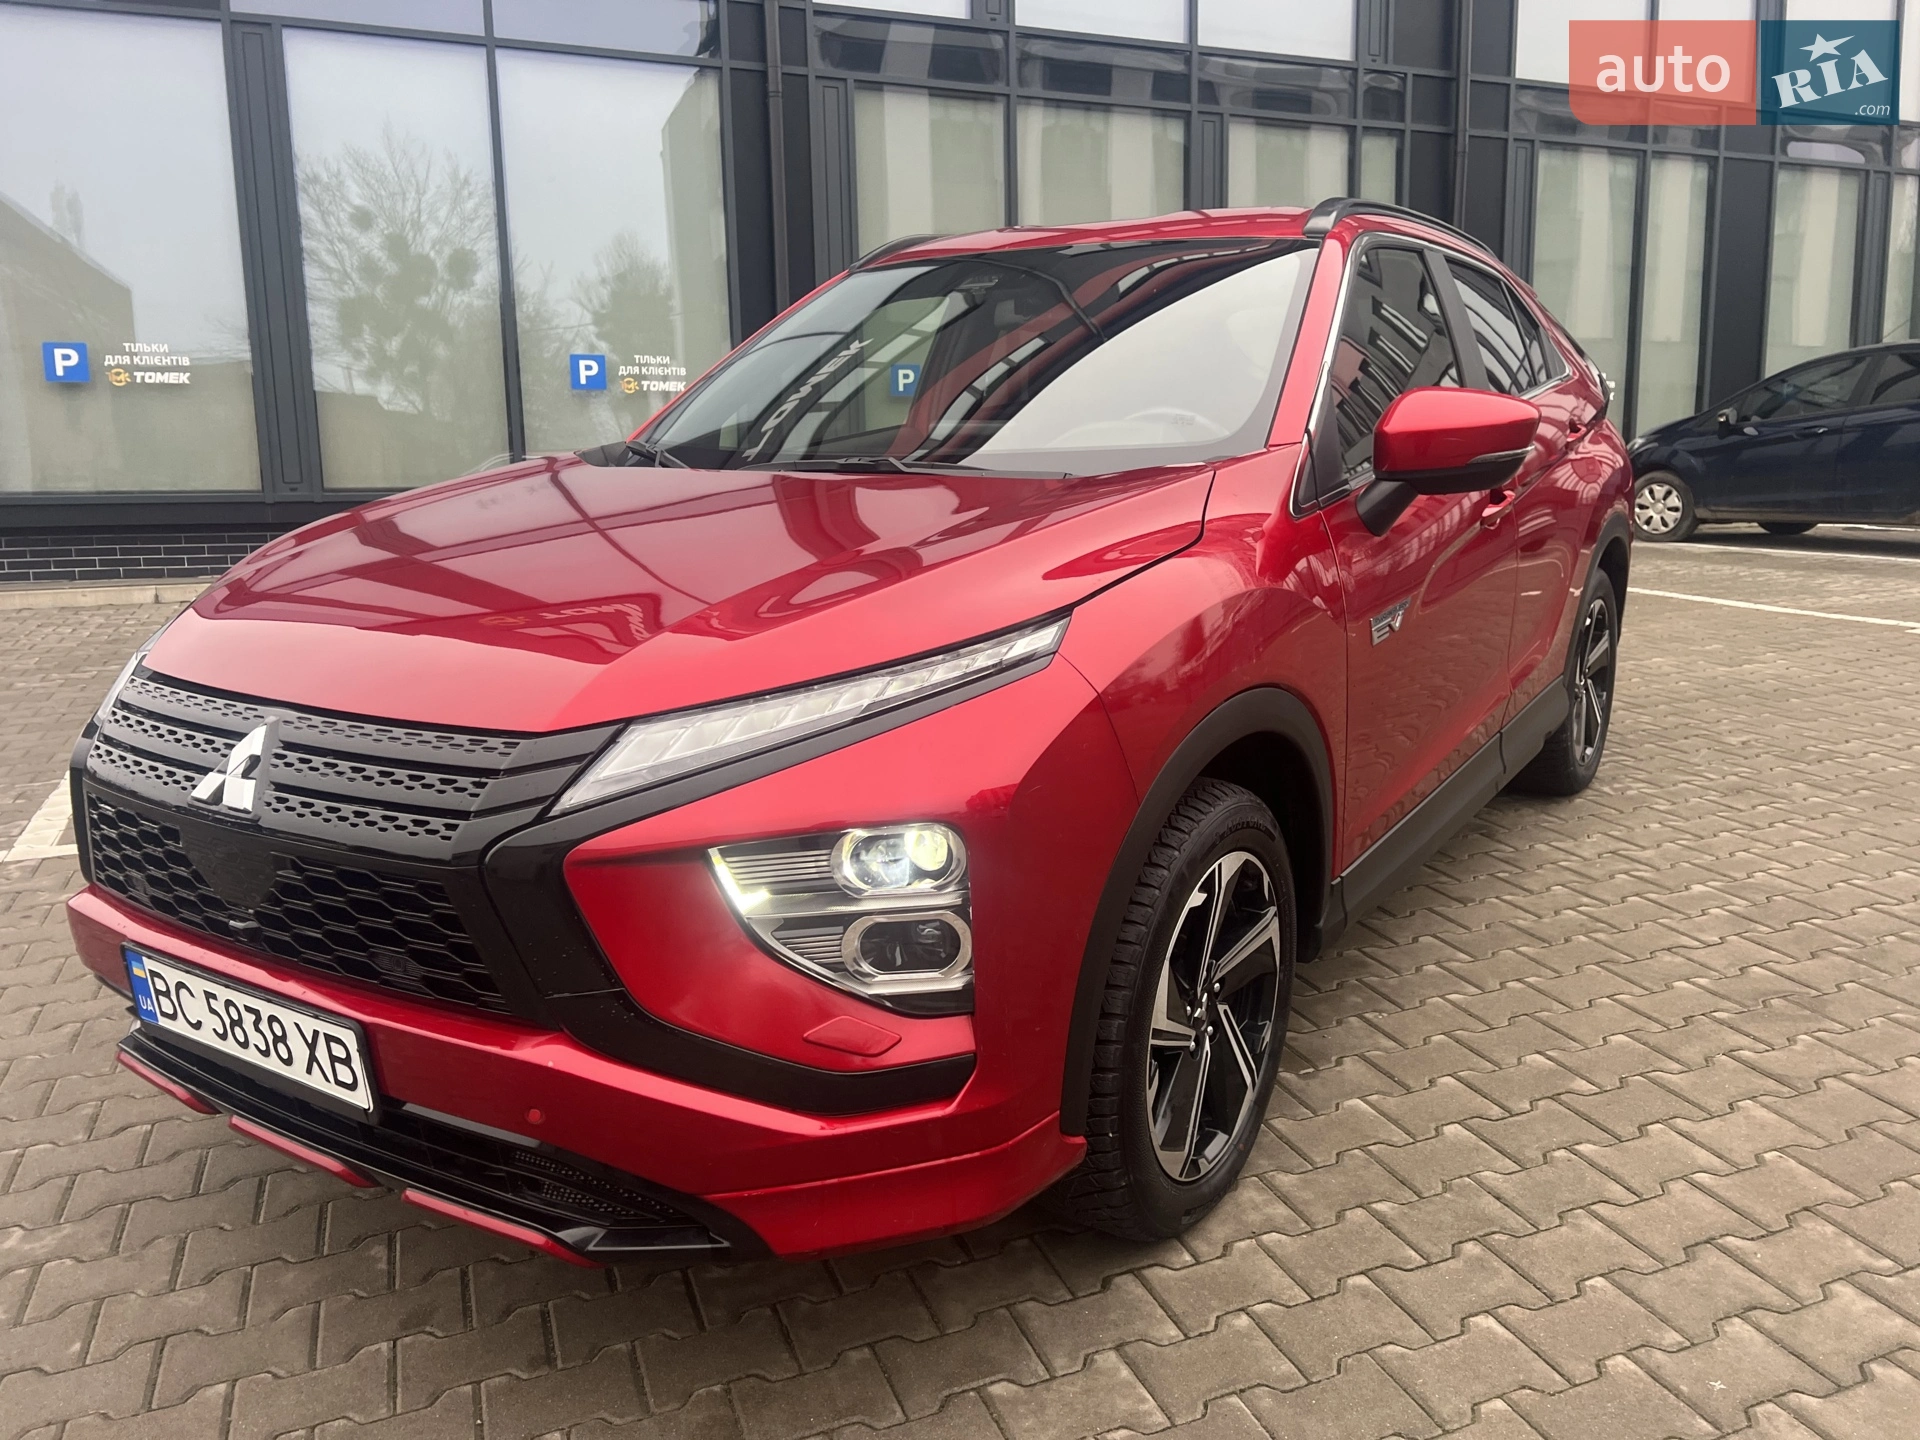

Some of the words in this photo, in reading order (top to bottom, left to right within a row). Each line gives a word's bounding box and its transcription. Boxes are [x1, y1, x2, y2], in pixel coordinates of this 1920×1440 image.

[122, 342, 169, 353] ТІЛЬКИ
[54, 348, 79, 377] P
[104, 354, 131, 367] ДЛЯ
[132, 355, 191, 366] КЛІЄНТІВ
[633, 354, 671, 365] ТІЛЬКИ
[578, 359, 599, 385] P
[618, 365, 640, 377] ДЛЯ
[641, 366, 687, 376] КЛІЄНТІВ
[897, 369, 915, 392] P
[138, 994, 155, 1012] UA
[148, 968, 203, 1031] BC
[203, 989, 294, 1067] 5838
[293, 1021, 359, 1092] XB
